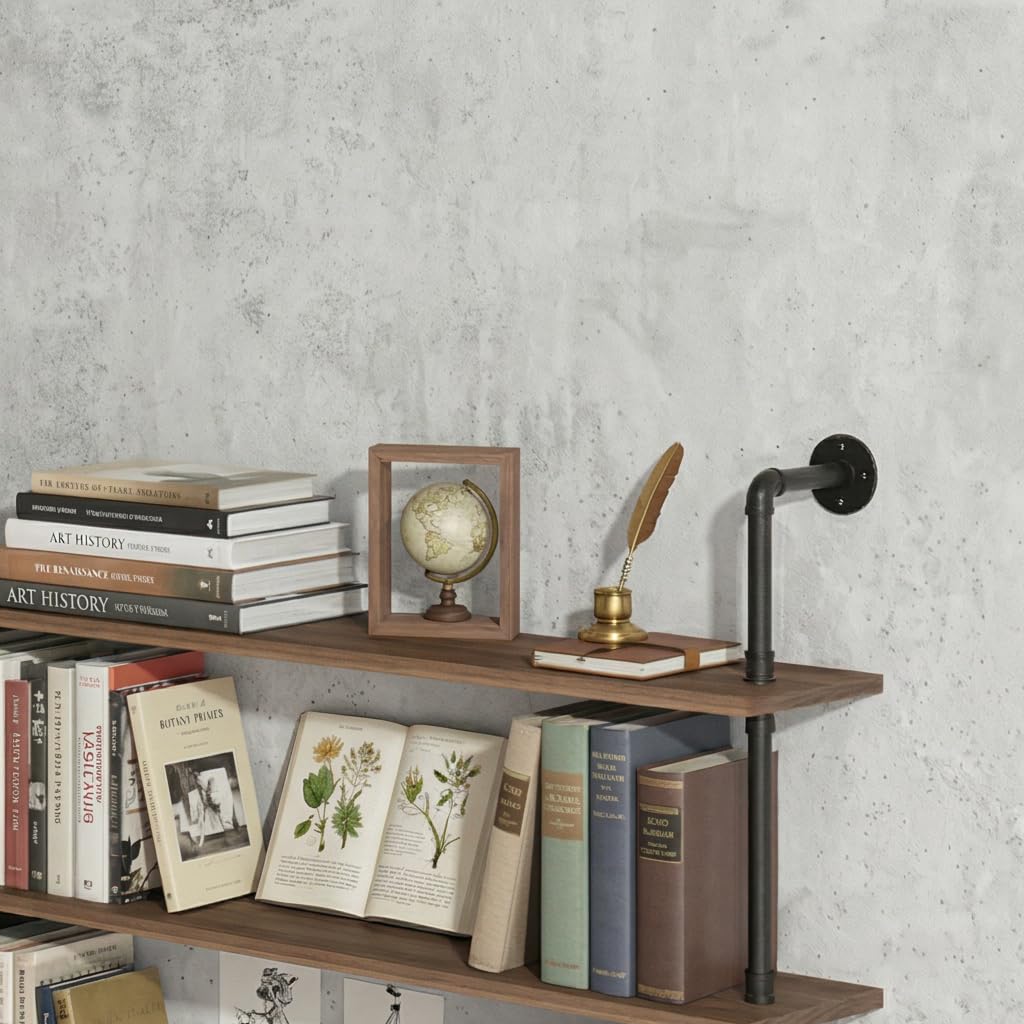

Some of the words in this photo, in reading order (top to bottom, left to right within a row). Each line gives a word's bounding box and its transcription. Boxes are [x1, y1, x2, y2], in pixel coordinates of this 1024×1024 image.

[49, 532, 72, 544] ART
[74, 533, 126, 550] HISTORY
[7, 586, 37, 605] ART
[41, 589, 109, 614] HISTORY
